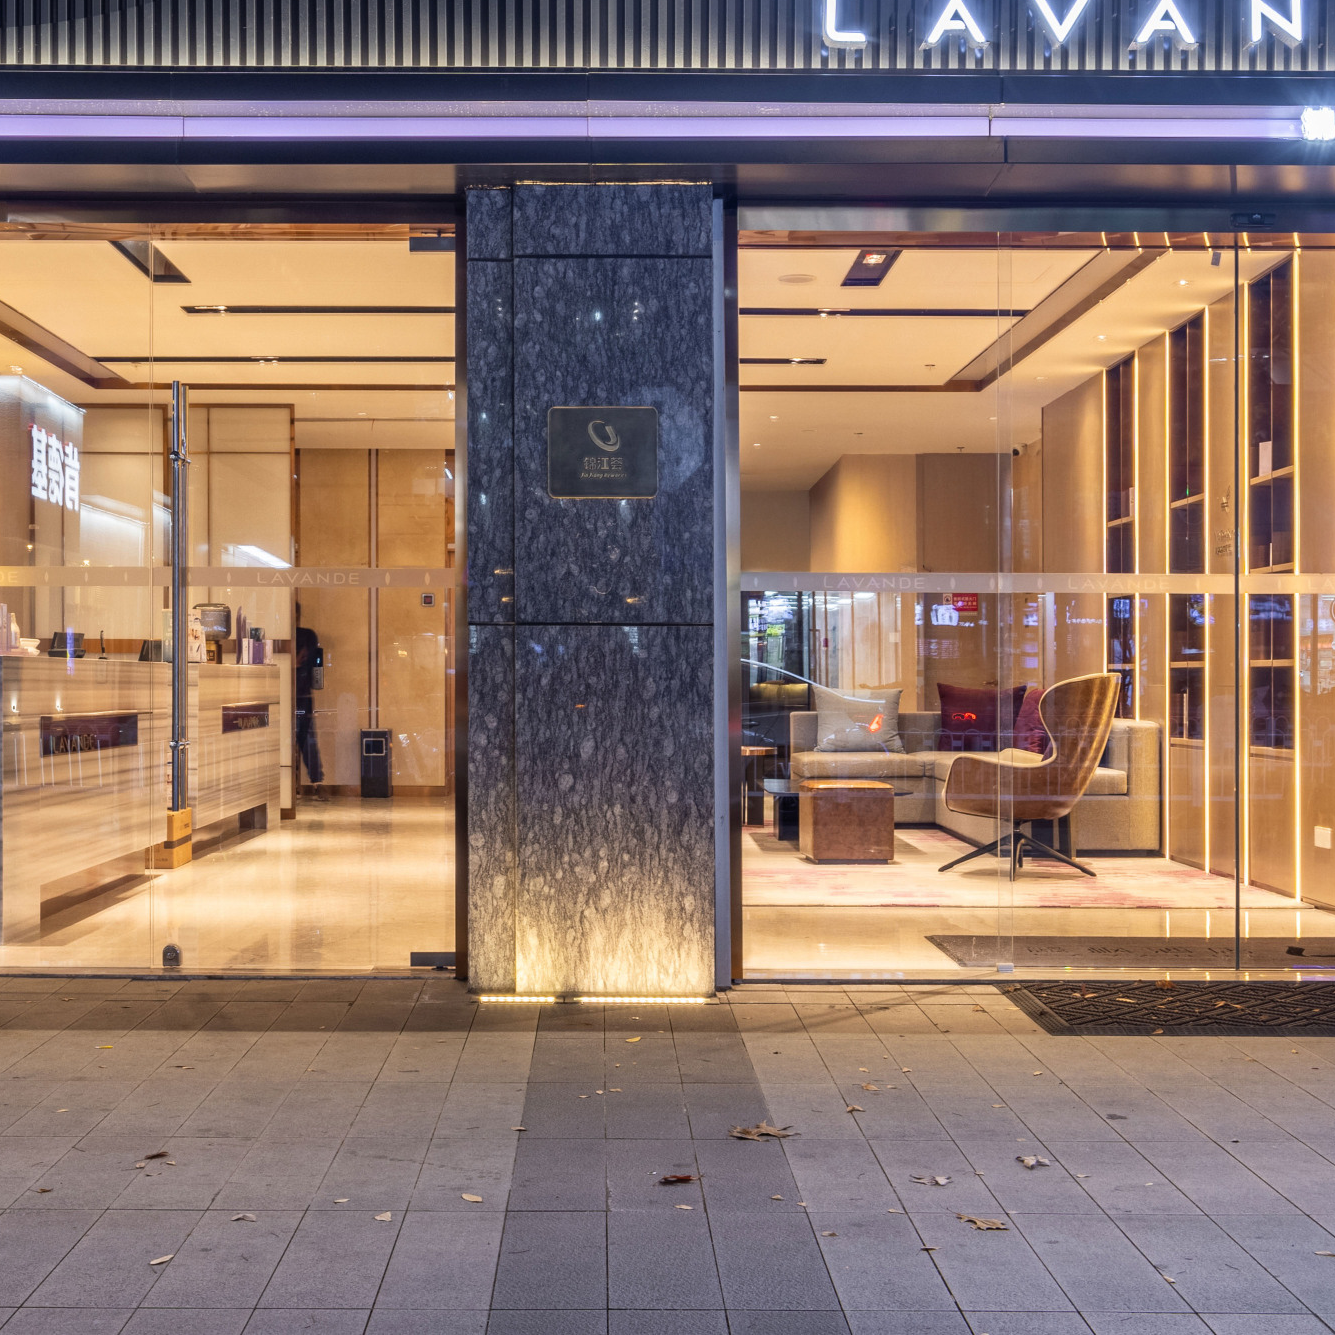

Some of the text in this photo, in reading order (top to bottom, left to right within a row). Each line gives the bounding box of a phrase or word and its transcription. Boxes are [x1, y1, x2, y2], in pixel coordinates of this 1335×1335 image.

[257, 572, 360, 585] LAVANDE
[823, 576, 926, 589] LAVANDE
[1067, 577, 1171, 590] LAVANDE
